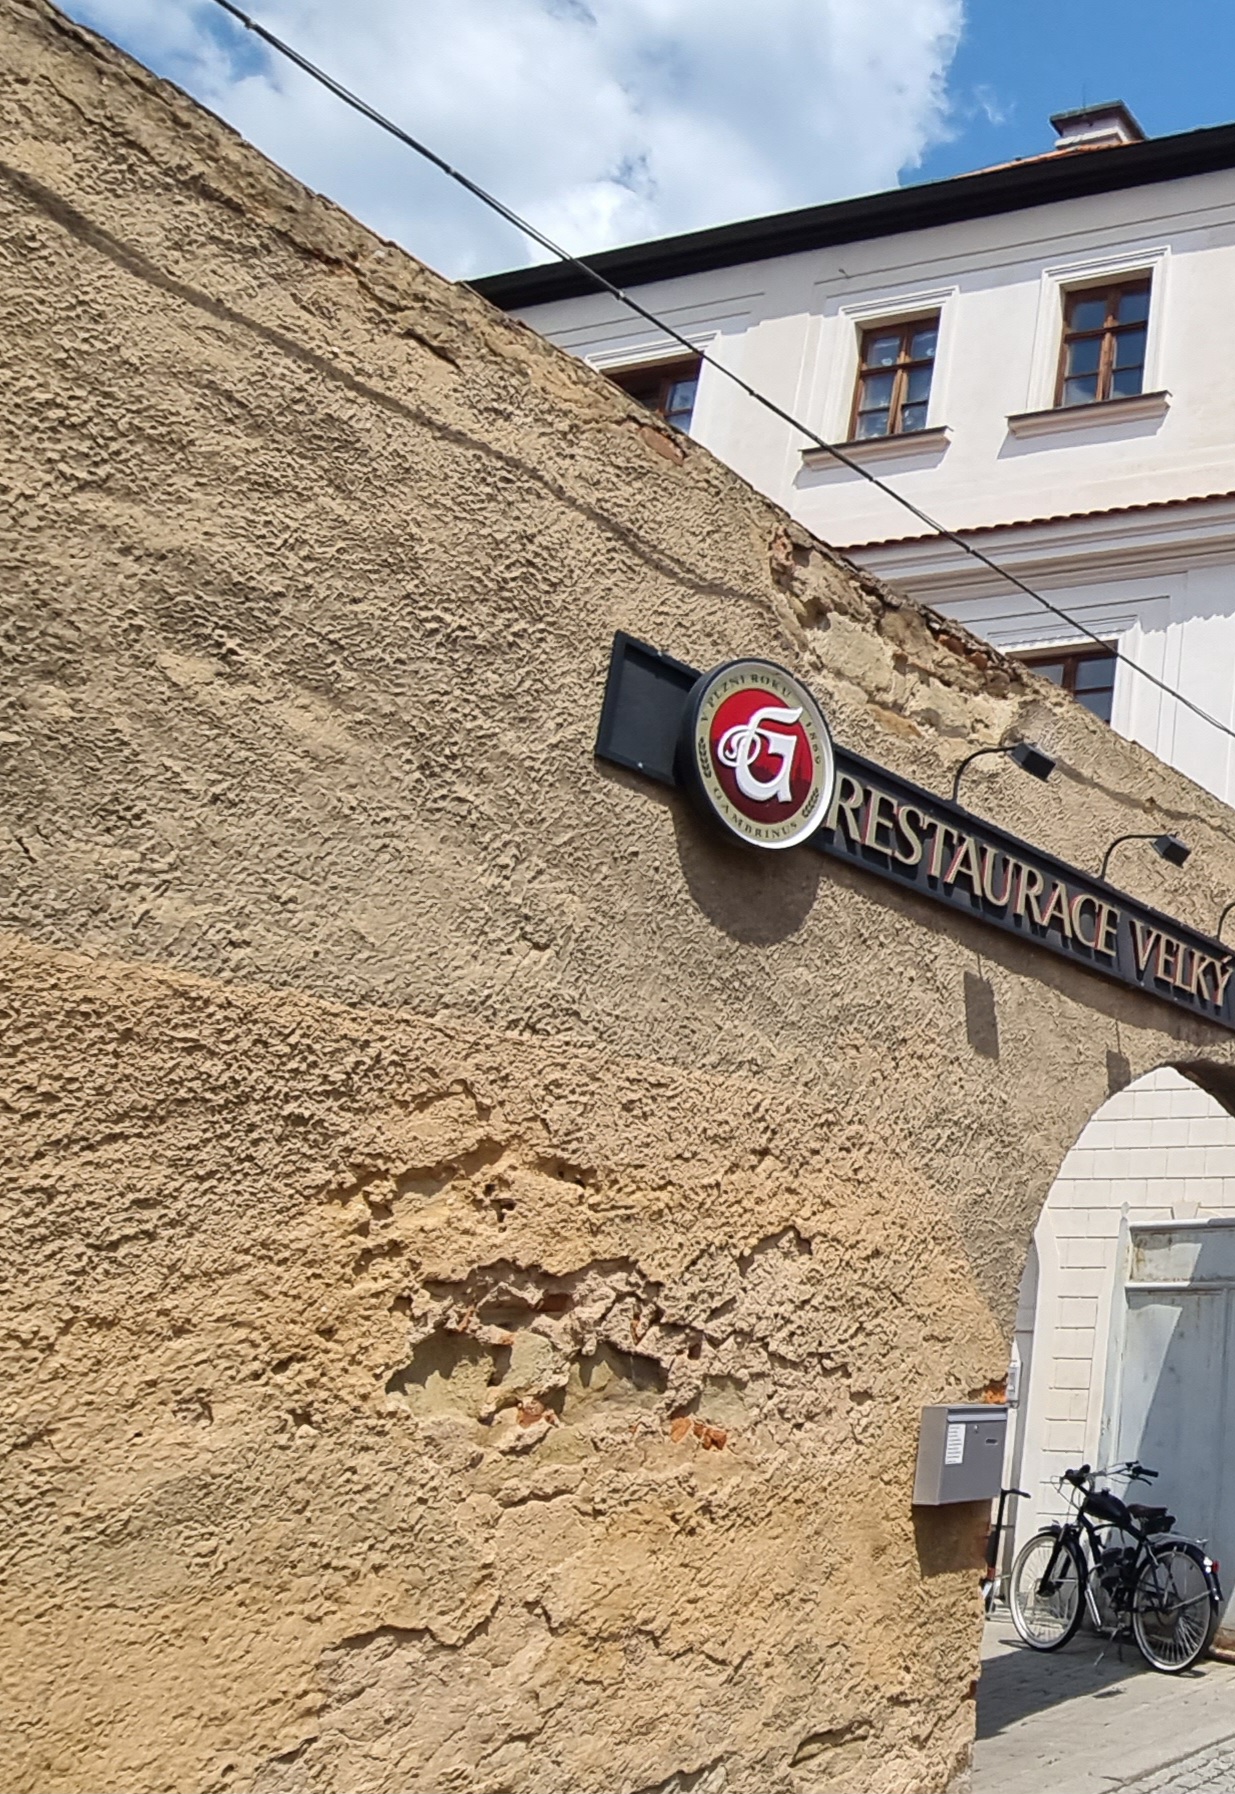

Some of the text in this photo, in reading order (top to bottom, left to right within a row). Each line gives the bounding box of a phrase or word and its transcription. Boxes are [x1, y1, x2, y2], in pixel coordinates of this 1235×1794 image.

[707, 675, 745, 708] PLZNI
[750, 674, 792, 698] ROKU
[713, 787, 798, 838] GAMBRINUS
[825, 771, 1121, 957] RESTAURACE
[1129, 919, 1234, 1007] VELKÝ
